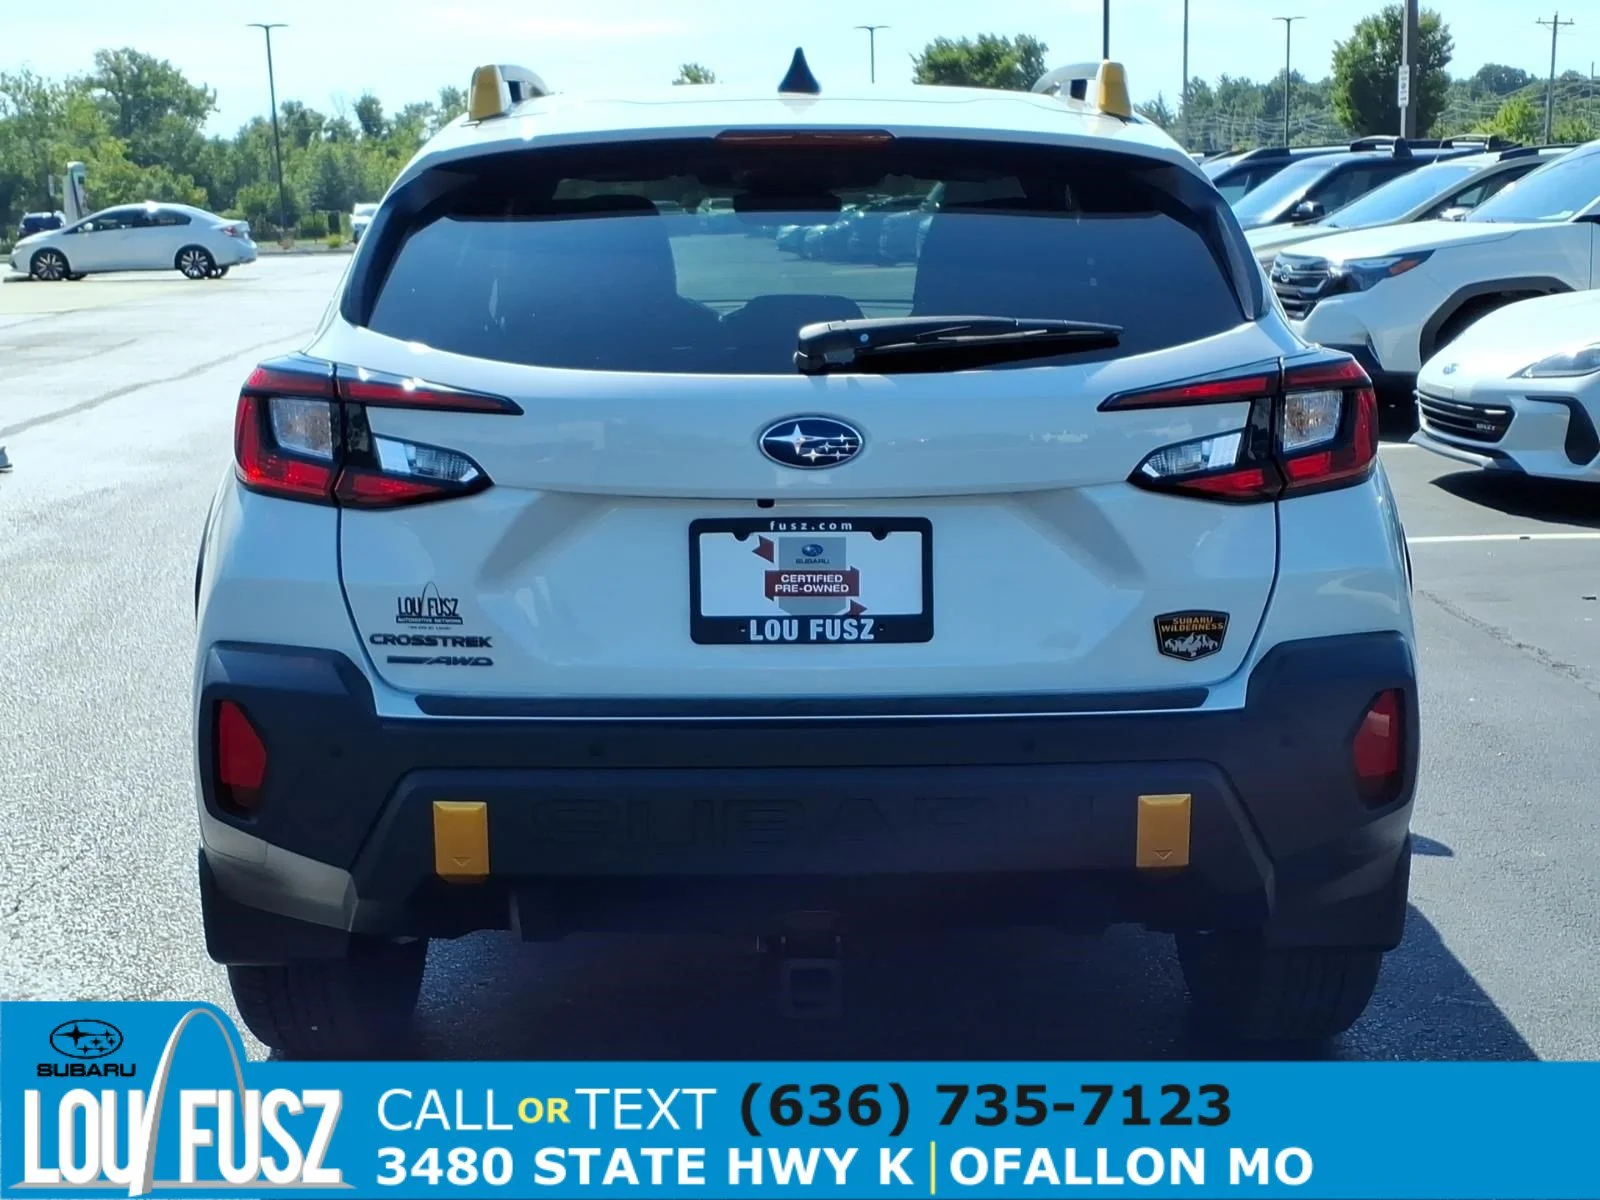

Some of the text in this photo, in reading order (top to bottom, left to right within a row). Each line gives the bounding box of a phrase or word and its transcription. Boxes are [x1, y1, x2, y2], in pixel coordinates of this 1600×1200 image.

[769, 520, 853, 531] fusz.com
[780, 574, 843, 583] CERTIFIED
[774, 584, 850, 593] PRE-OWNED
[396, 596, 459, 617] LOU FUSZ
[1172, 616, 1213, 625] SUBARU
[749, 618, 875, 641] LOU FUSZ
[1161, 623, 1224, 633] WILDERNESS
[369, 633, 493, 648] CROSSTREK
[426, 655, 494, 667] AWD
